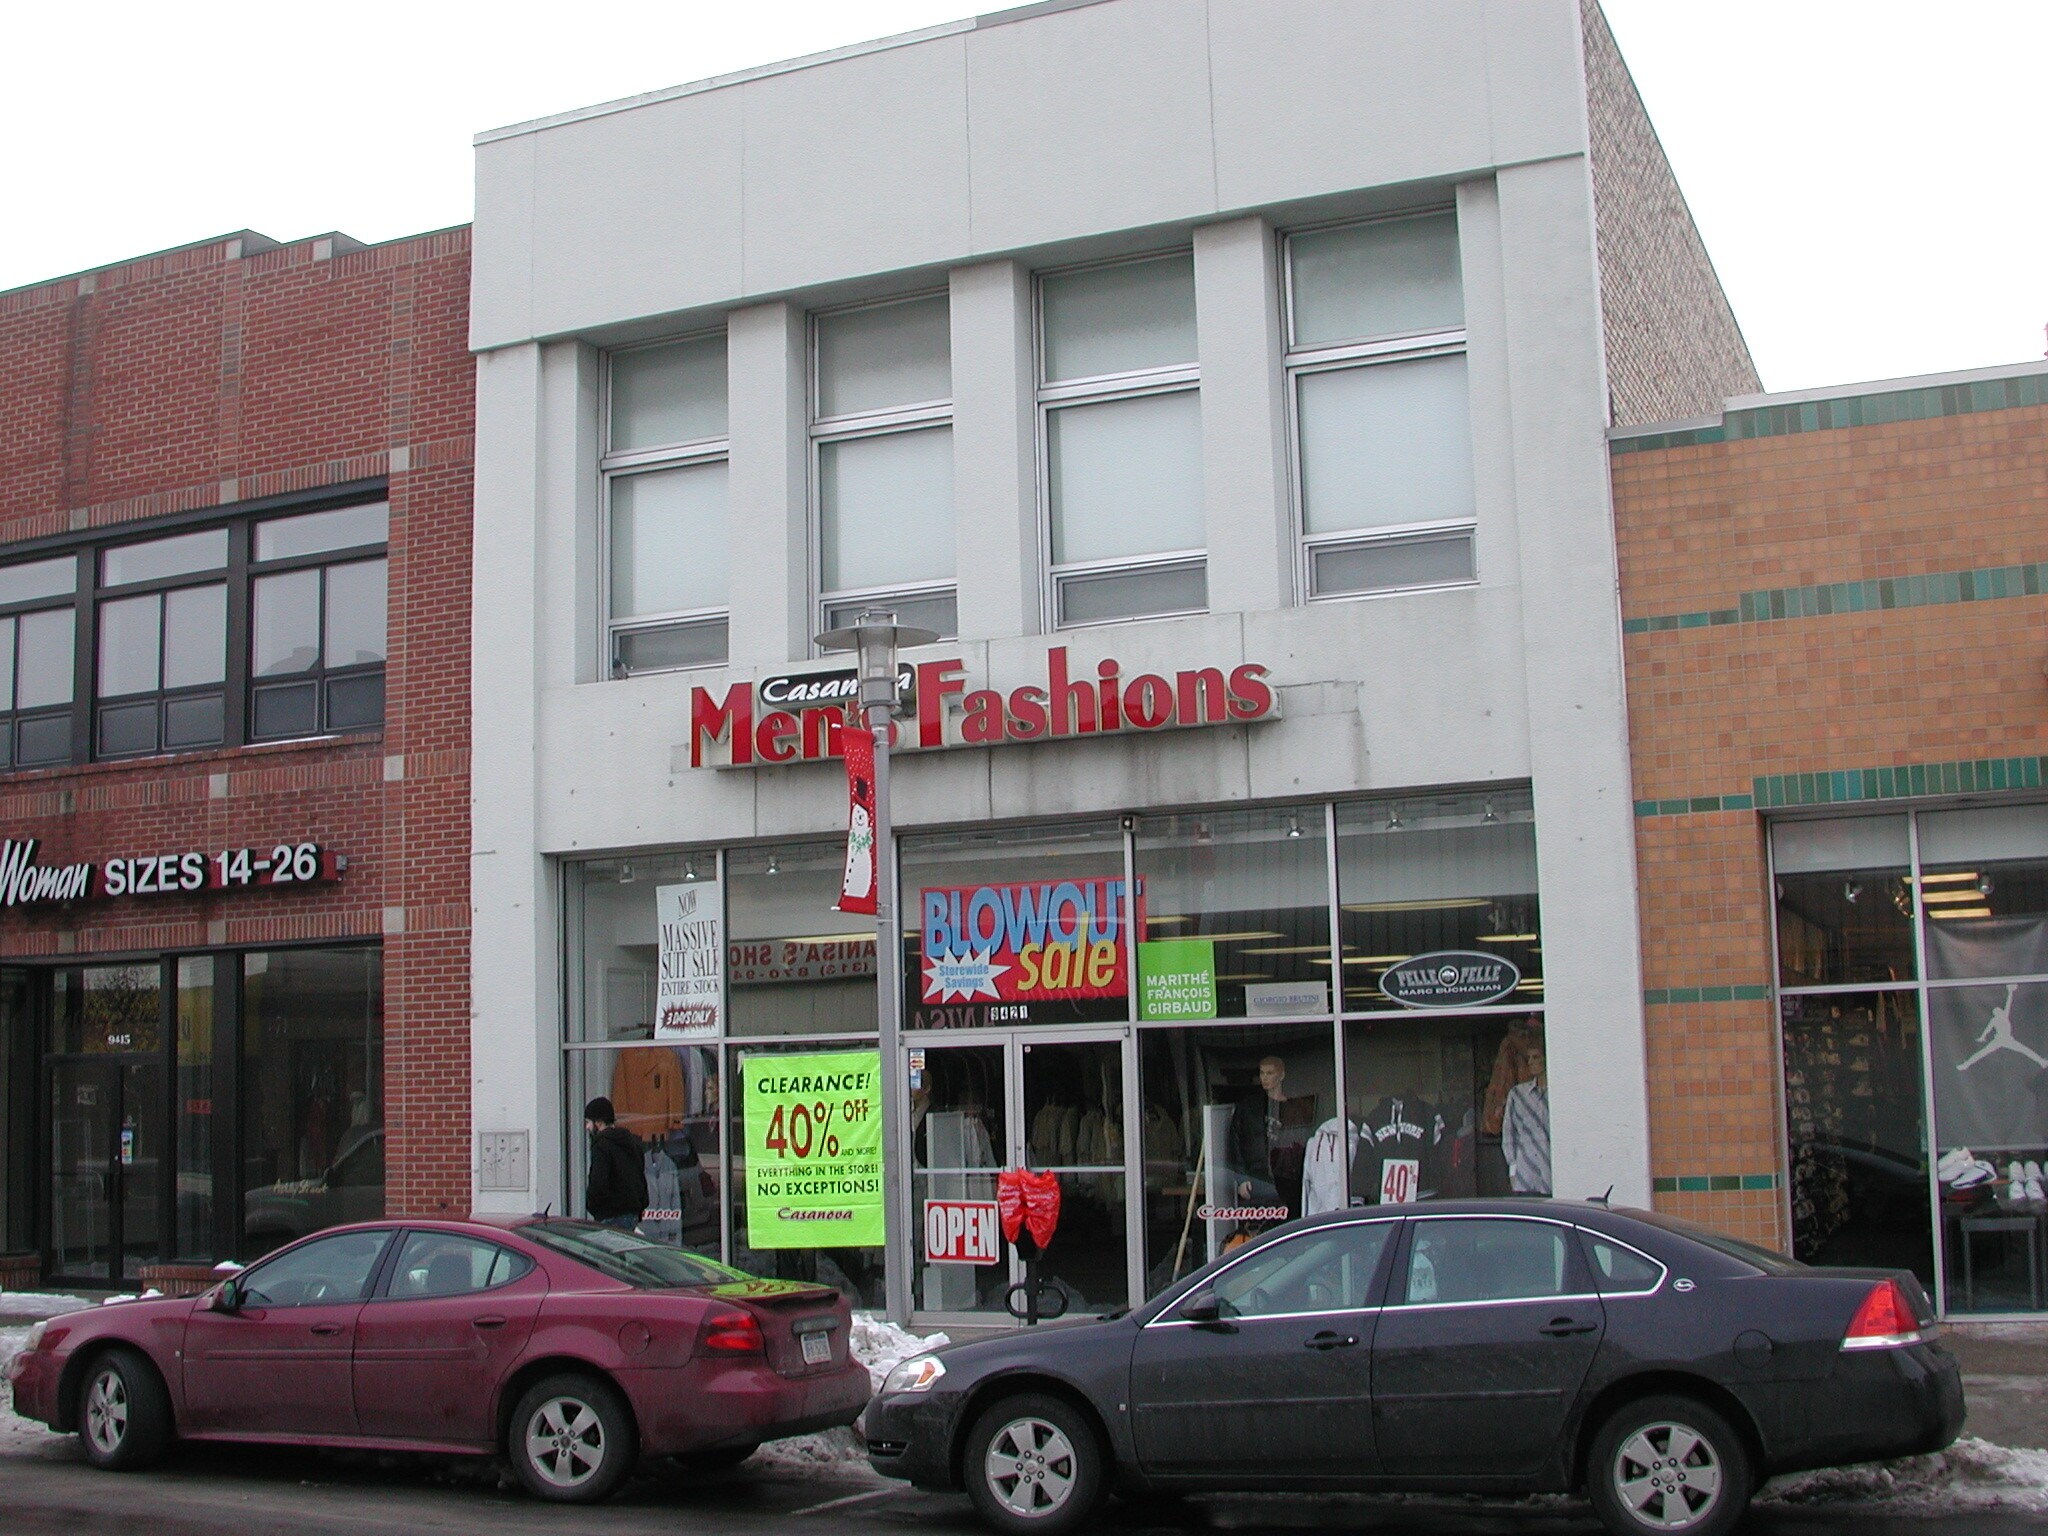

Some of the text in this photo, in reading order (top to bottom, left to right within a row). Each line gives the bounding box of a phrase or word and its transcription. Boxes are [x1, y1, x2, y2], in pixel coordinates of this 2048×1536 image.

[763, 672, 912, 702] Casana
[917, 646, 1272, 748] Fashions
[0, 838, 318, 907] Woman SIZES 14-26
[677, 890, 698, 915] NOW
[662, 920, 719, 952] MASSIVE
[1017, 911, 1116, 991] sale
[661, 948, 719, 980] SUIT SALE
[939, 963, 990, 977] Storewide
[945, 976, 985, 989] Savings
[1146, 970, 1210, 987] MARITHÉ
[1396, 964, 1502, 988] PELLE PELLE
[661, 978, 720, 997] ENTIRE STOCK
[1147, 986, 1212, 1001] FRANÇOIS
[1398, 983, 1502, 997] MARC BUCHANAN
[990, 1004, 1029, 1021] 9421
[1148, 1000, 1213, 1015] GIRBAUD
[107, 1033, 132, 1046] 9415
[757, 1073, 871, 1094] CLEARANCE!
[765, 1099, 869, 1159] 40% OFF
[1374, 1123, 1397, 1142] NEW
[757, 1167, 813, 1178] EVERYTHING
[829, 1166, 845, 1175] THE
[849, 1163, 879, 1174] STORE!
[757, 1179, 879, 1196] NO EXCEPTIONS!
[1384, 1164, 1417, 1204] 40%
[641, 1208, 681, 1220] nova
[776, 1207, 854, 1222] Casanova
[1197, 1204, 1288, 1220] Casanova
[928, 1206, 996, 1258] OPEN
